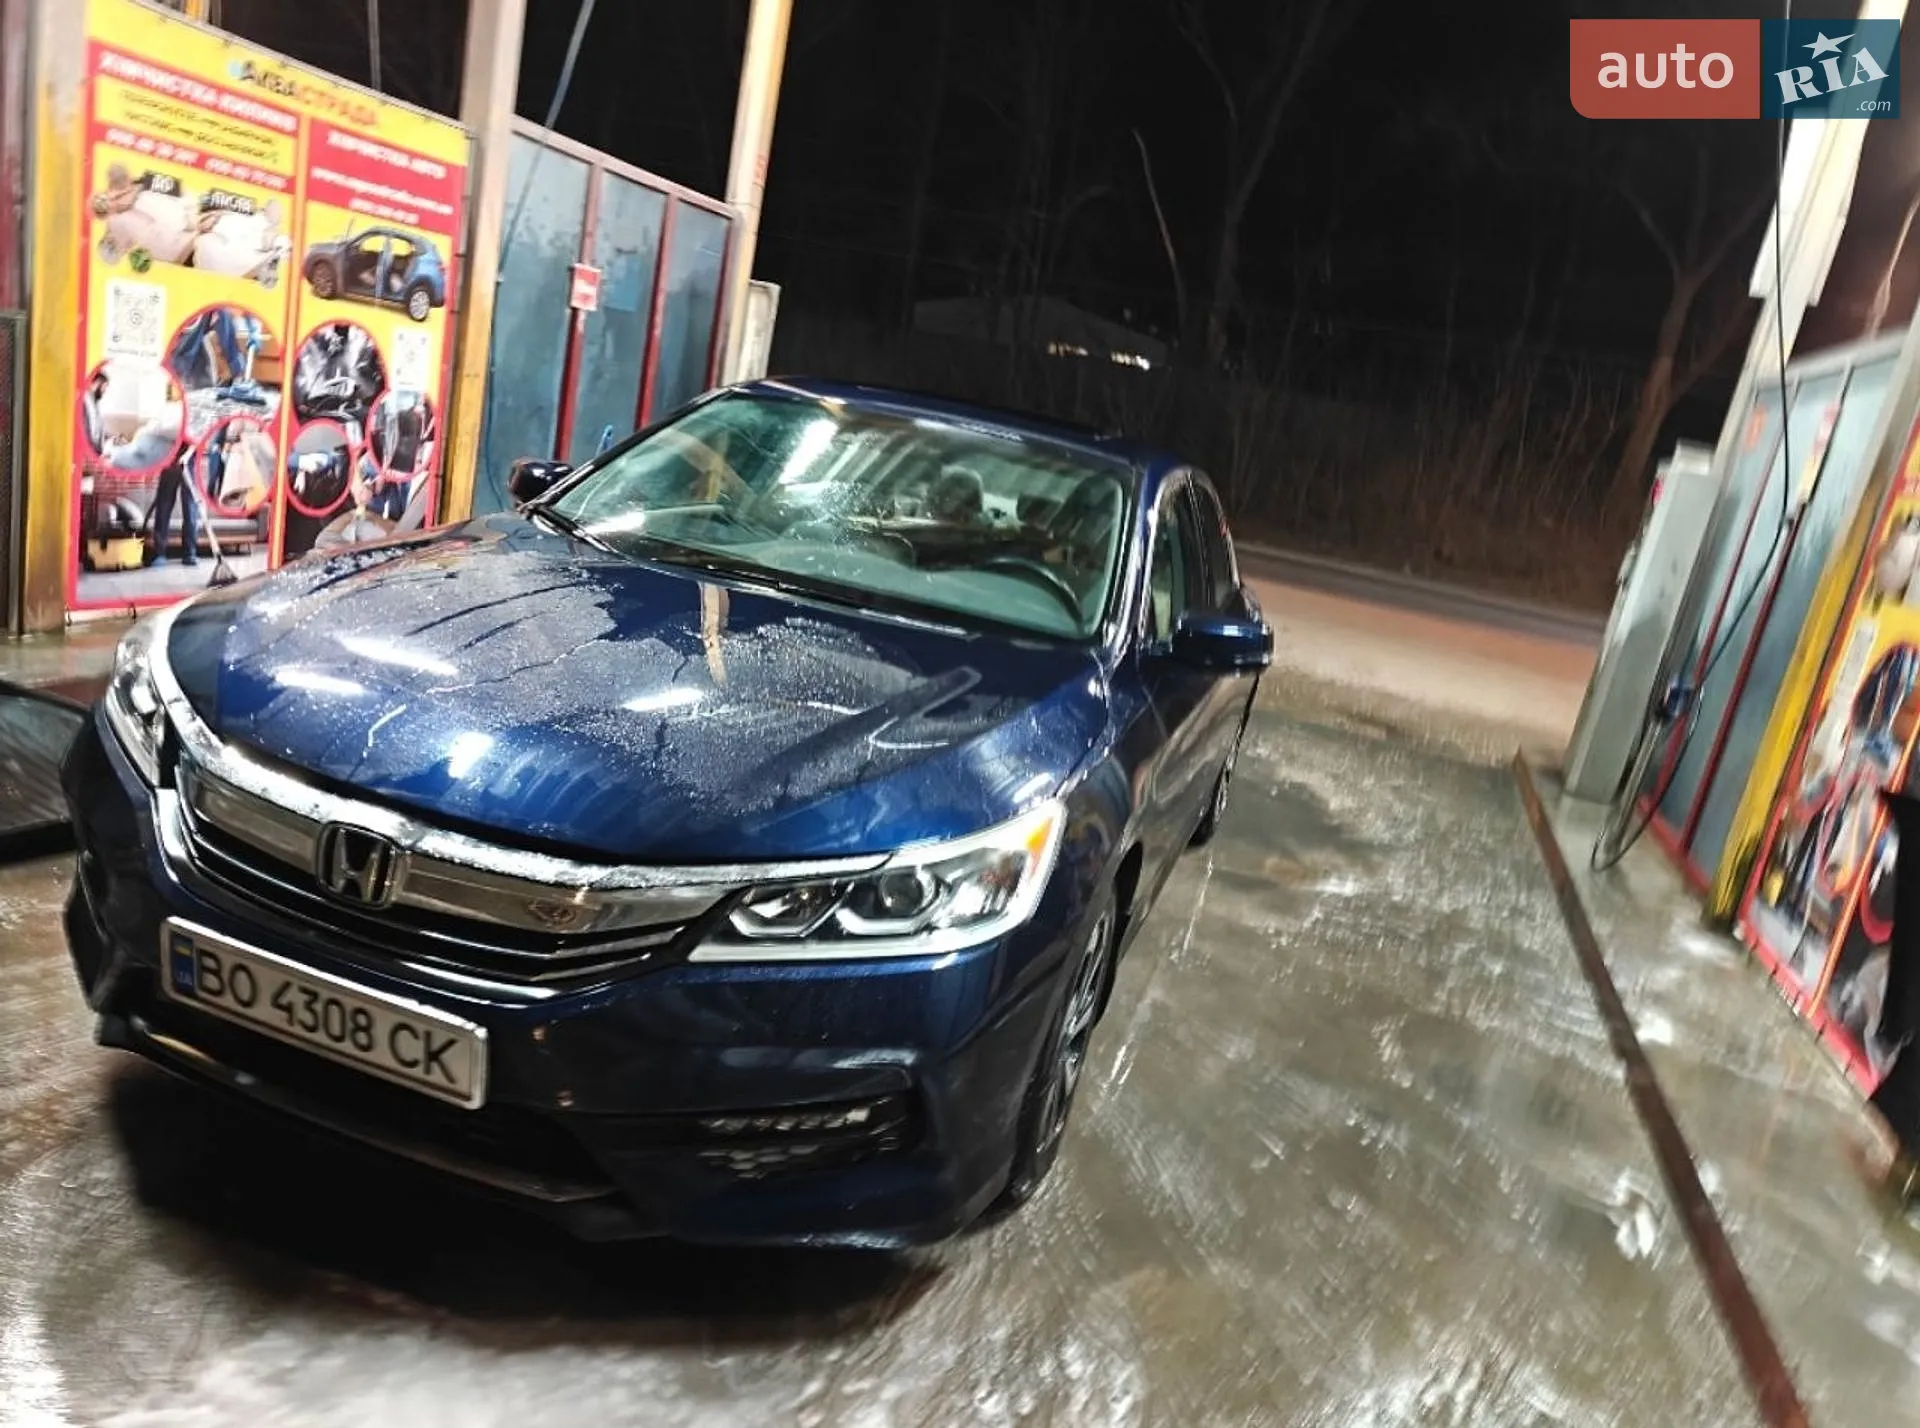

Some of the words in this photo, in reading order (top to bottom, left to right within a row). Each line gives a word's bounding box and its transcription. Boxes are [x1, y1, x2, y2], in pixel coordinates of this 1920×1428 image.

[199, 948, 258, 1009] BO
[270, 980, 375, 1053] 4308
[389, 1022, 458, 1084] CK
